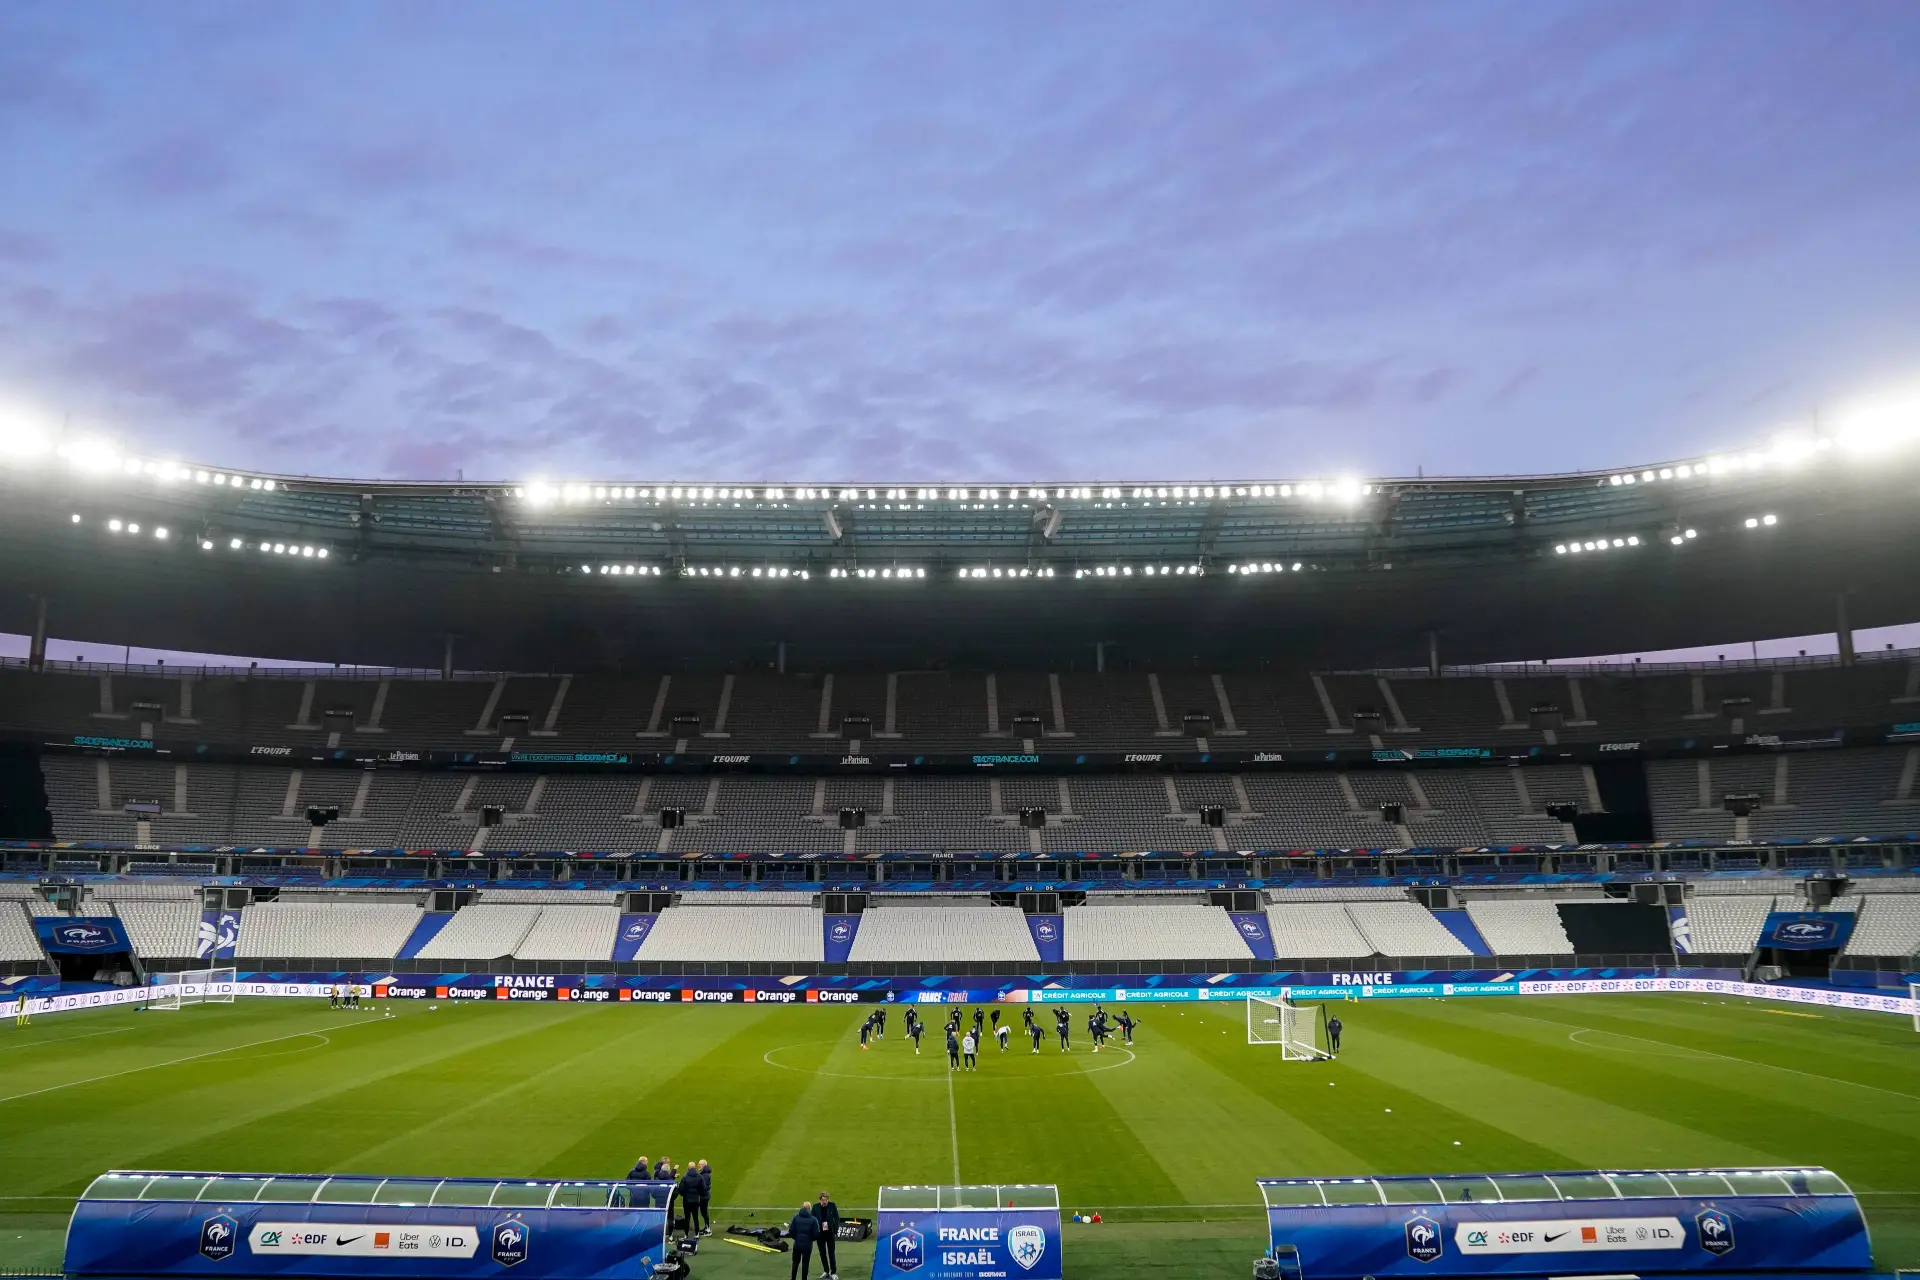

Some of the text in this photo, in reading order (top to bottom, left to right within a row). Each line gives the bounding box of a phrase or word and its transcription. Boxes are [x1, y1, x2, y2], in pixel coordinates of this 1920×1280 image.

[396, 751, 419, 760] Parisien
[847, 756, 870, 764] Parisien
[1260, 753, 1282, 761] Parisien
[494, 975, 556, 988] FRANCE
[1332, 972, 1393, 985] FRANCE
[250, 985, 268, 994] ID.
[284, 986, 302, 994] ID.
[388, 986, 427, 998] Orange
[449, 987, 487, 999] Orange
[509, 988, 548, 1000] Orange
[632, 989, 671, 1000] Orange
[694, 990, 734, 1001] Orange
[756, 991, 796, 1001] Orange
[819, 991, 859, 1001] Orange
[917, 991, 943, 1002] FRANCE
[1070, 991, 1106, 999] AGRICOLE
[939, 1227, 999, 1242] FRANCE
[1015, 1230, 1038, 1238] ISRAEL
[1605, 1226, 1626, 1235] Uber
[1652, 1228, 1674, 1239] ID.
[400, 1233, 420, 1241] Uber
[445, 1237, 467, 1247] ID.
[1607, 1235, 1627, 1243] Eats
[398, 1242, 419, 1250] Eats
[942, 1249, 996, 1266] ISRAËL
